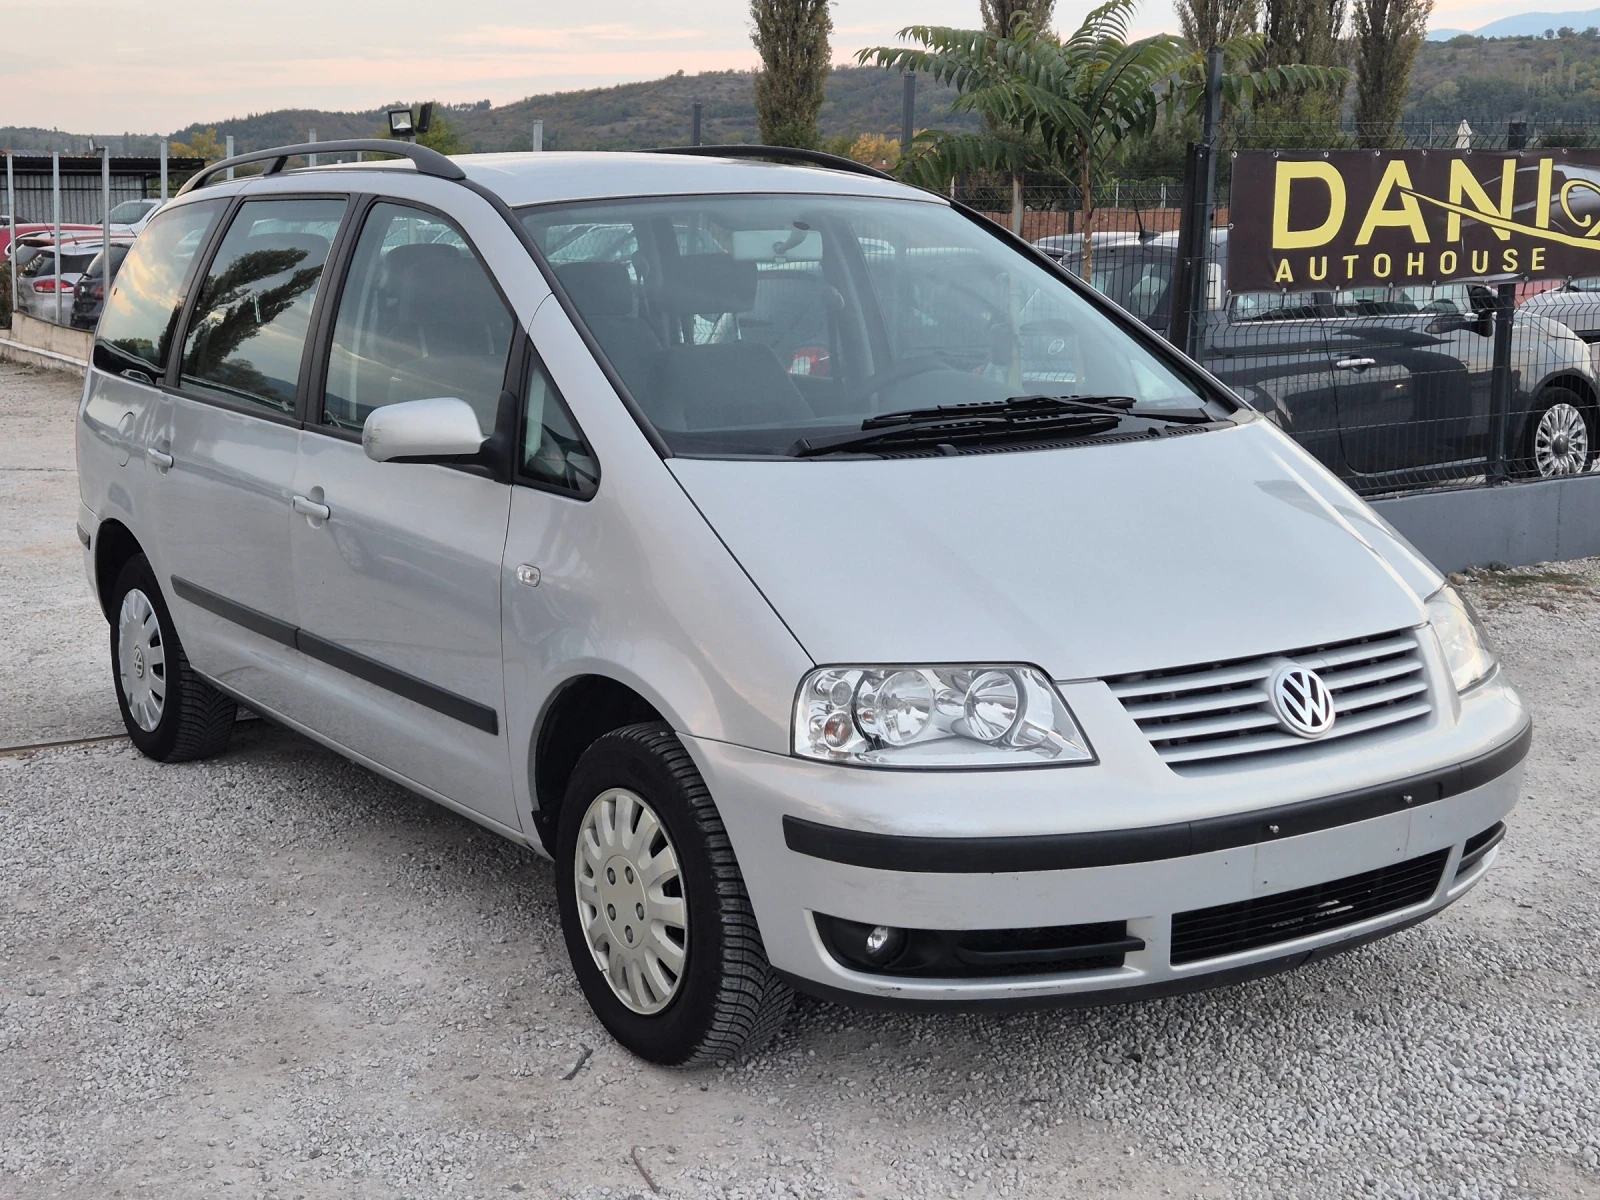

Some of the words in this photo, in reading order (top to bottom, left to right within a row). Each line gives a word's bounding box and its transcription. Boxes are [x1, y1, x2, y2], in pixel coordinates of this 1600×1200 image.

[1272, 158, 1553, 250] DANI
[1275, 247, 1545, 282] AUTOHOUSE
[1275, 666, 1334, 736] VW
